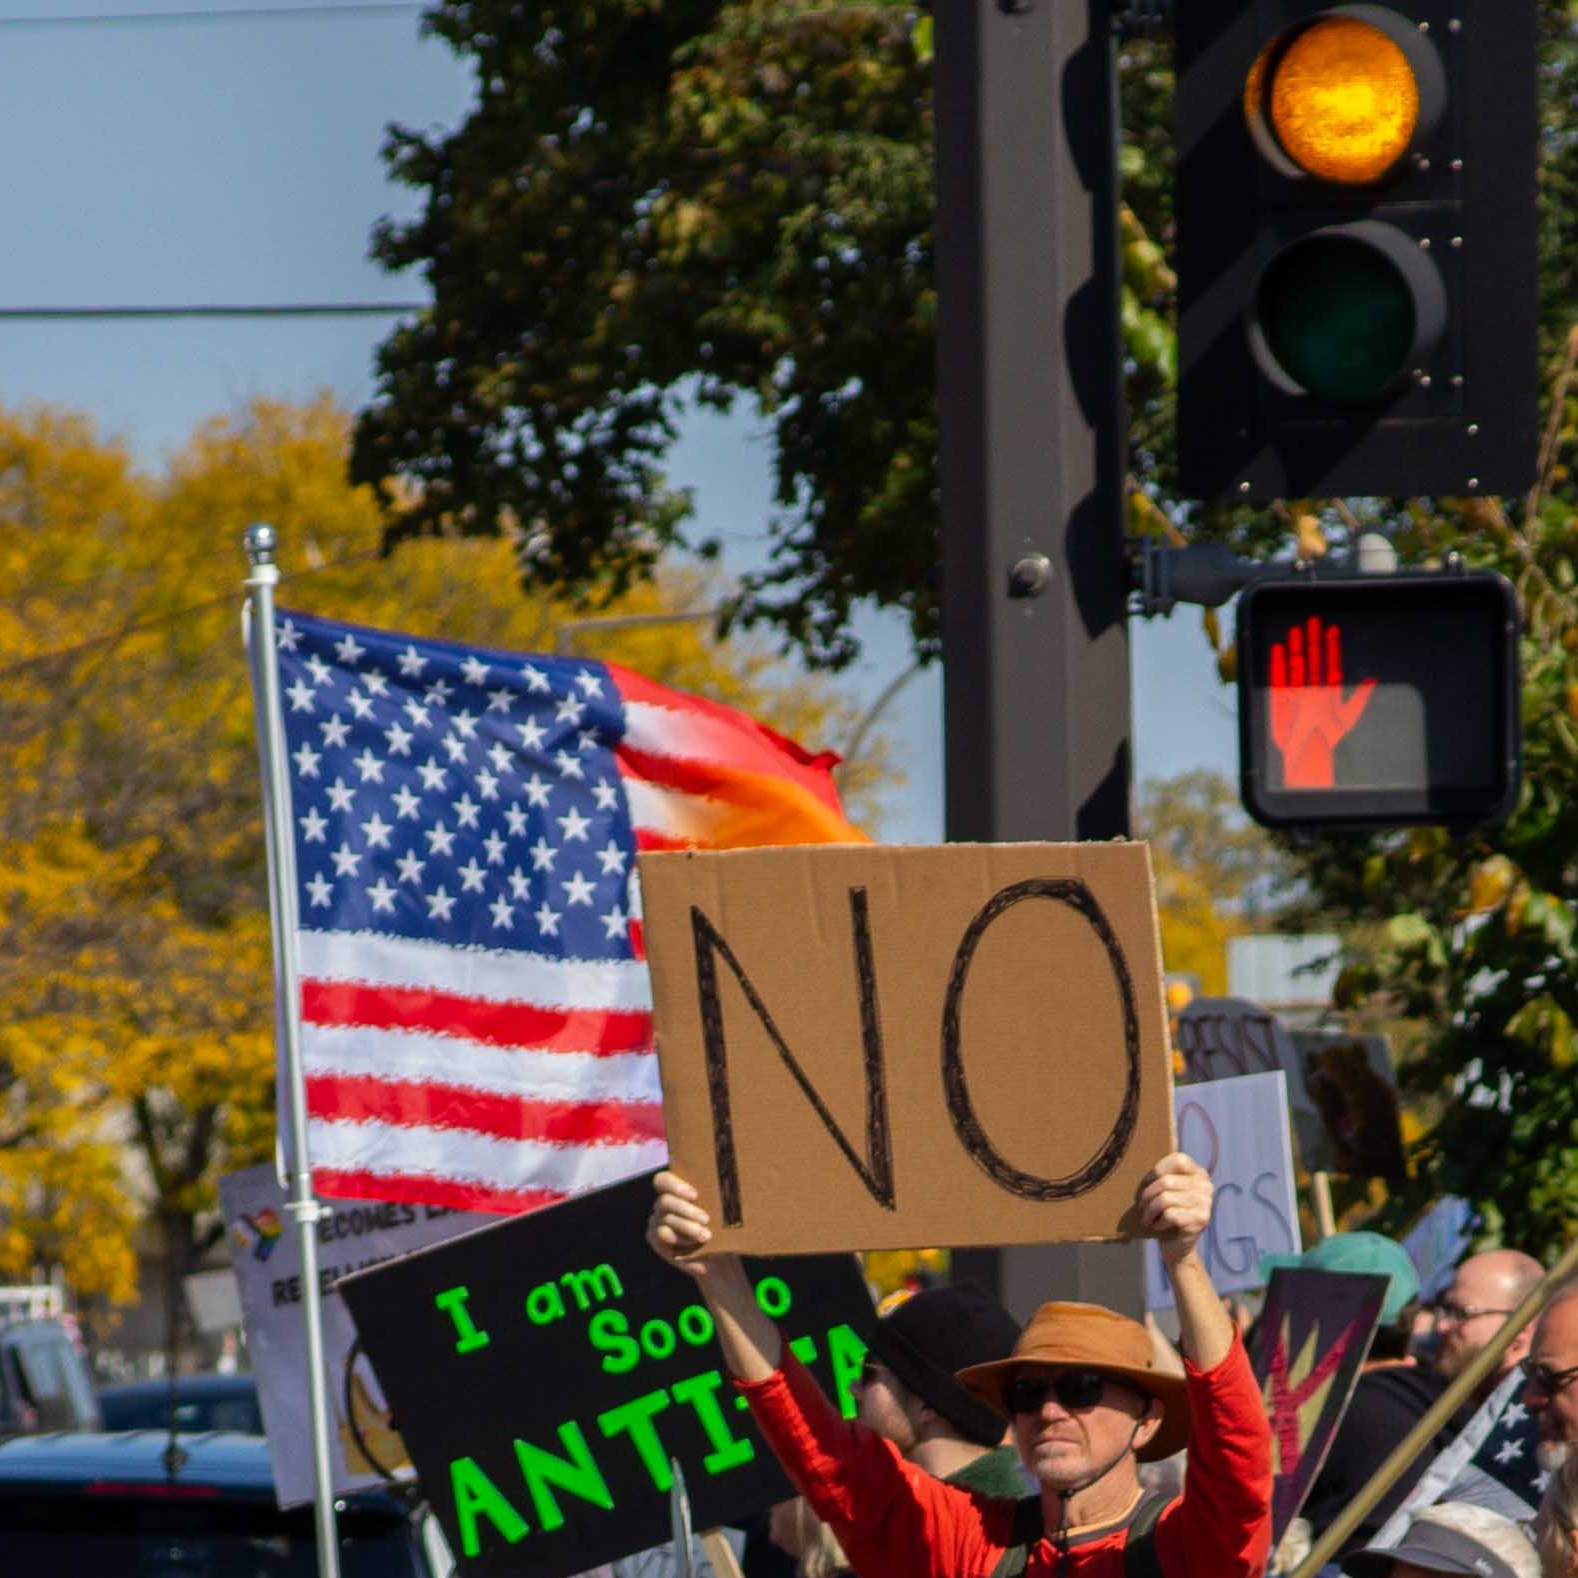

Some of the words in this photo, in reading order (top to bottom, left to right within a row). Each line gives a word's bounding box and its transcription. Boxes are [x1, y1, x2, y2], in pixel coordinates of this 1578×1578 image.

[690, 875, 1142, 1229] NO
[317, 1202, 415, 1243] ECOMES
[435, 1286, 490, 1354] I
[526, 1264, 623, 1326] am
